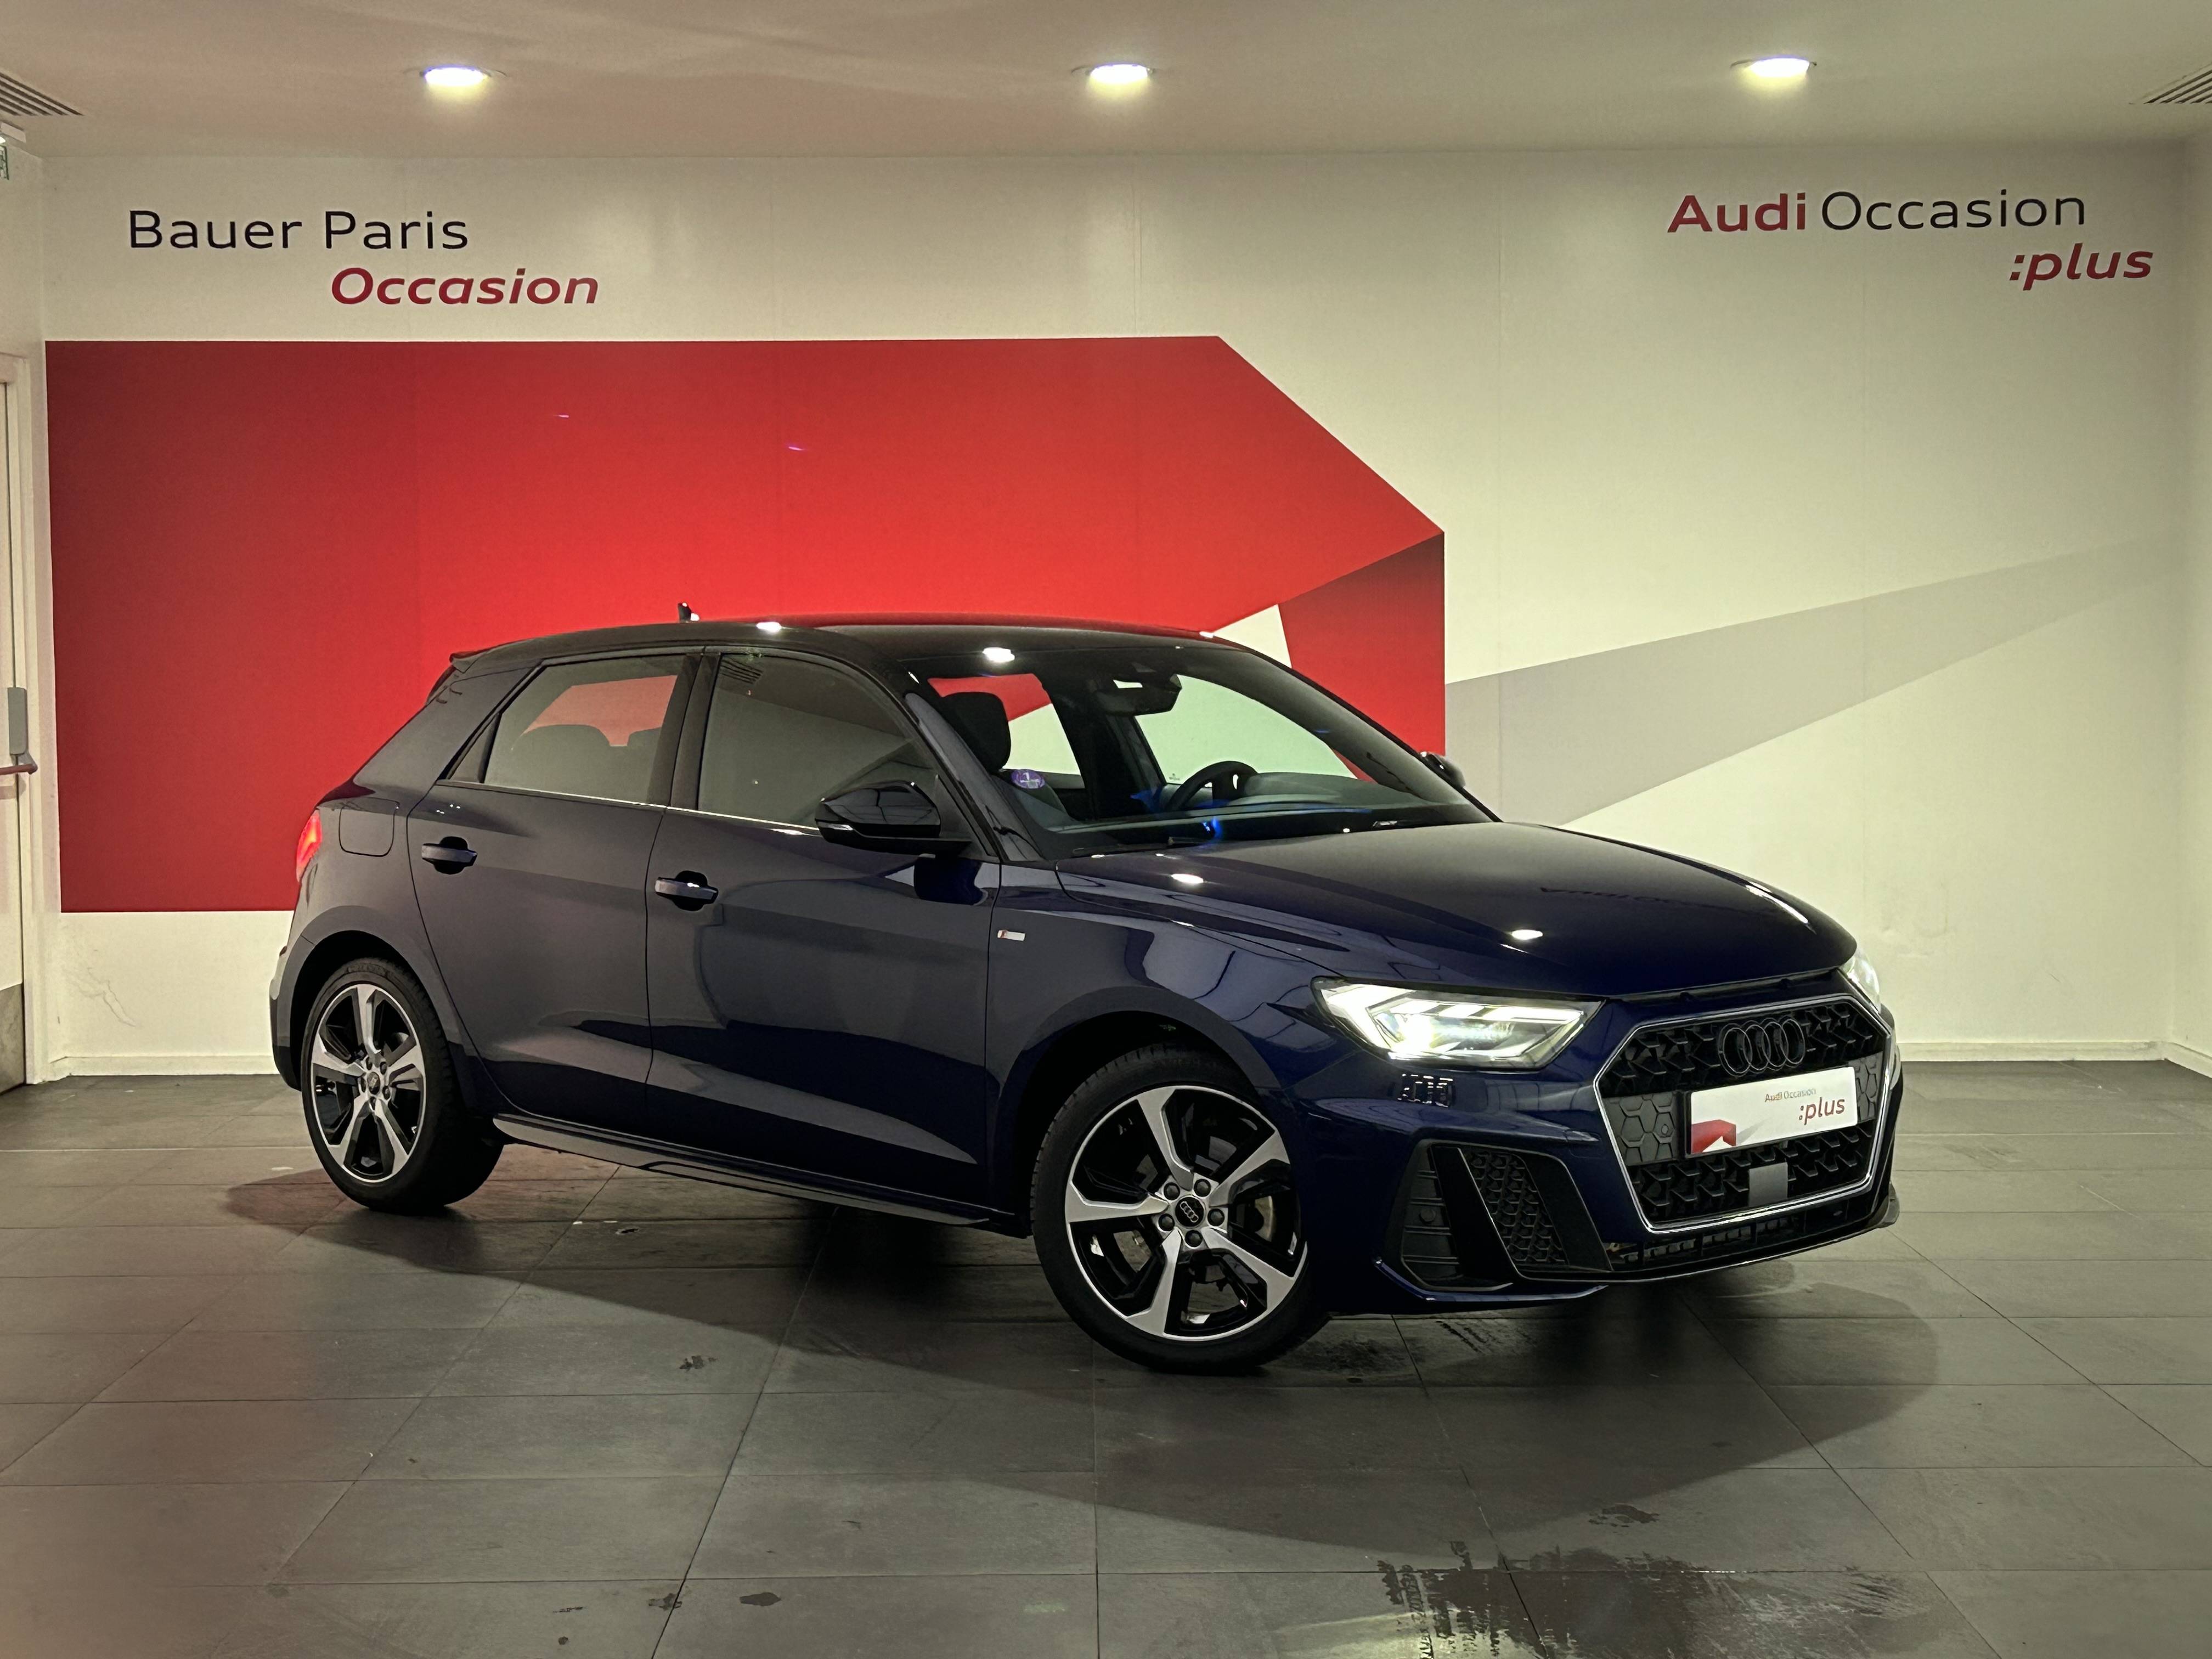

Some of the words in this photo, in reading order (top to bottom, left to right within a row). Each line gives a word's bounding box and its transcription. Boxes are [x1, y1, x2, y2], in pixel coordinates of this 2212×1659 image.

[129, 210, 302, 250] Bauer
[325, 211, 469, 250] Paris
[1667, 192, 1807, 233] Audi
[1821, 189, 2085, 230] Occasion
[331, 267, 599, 305] Occasion
[2009, 242, 2154, 291] :plus
[1798, 1096, 1846, 1126] :plus
